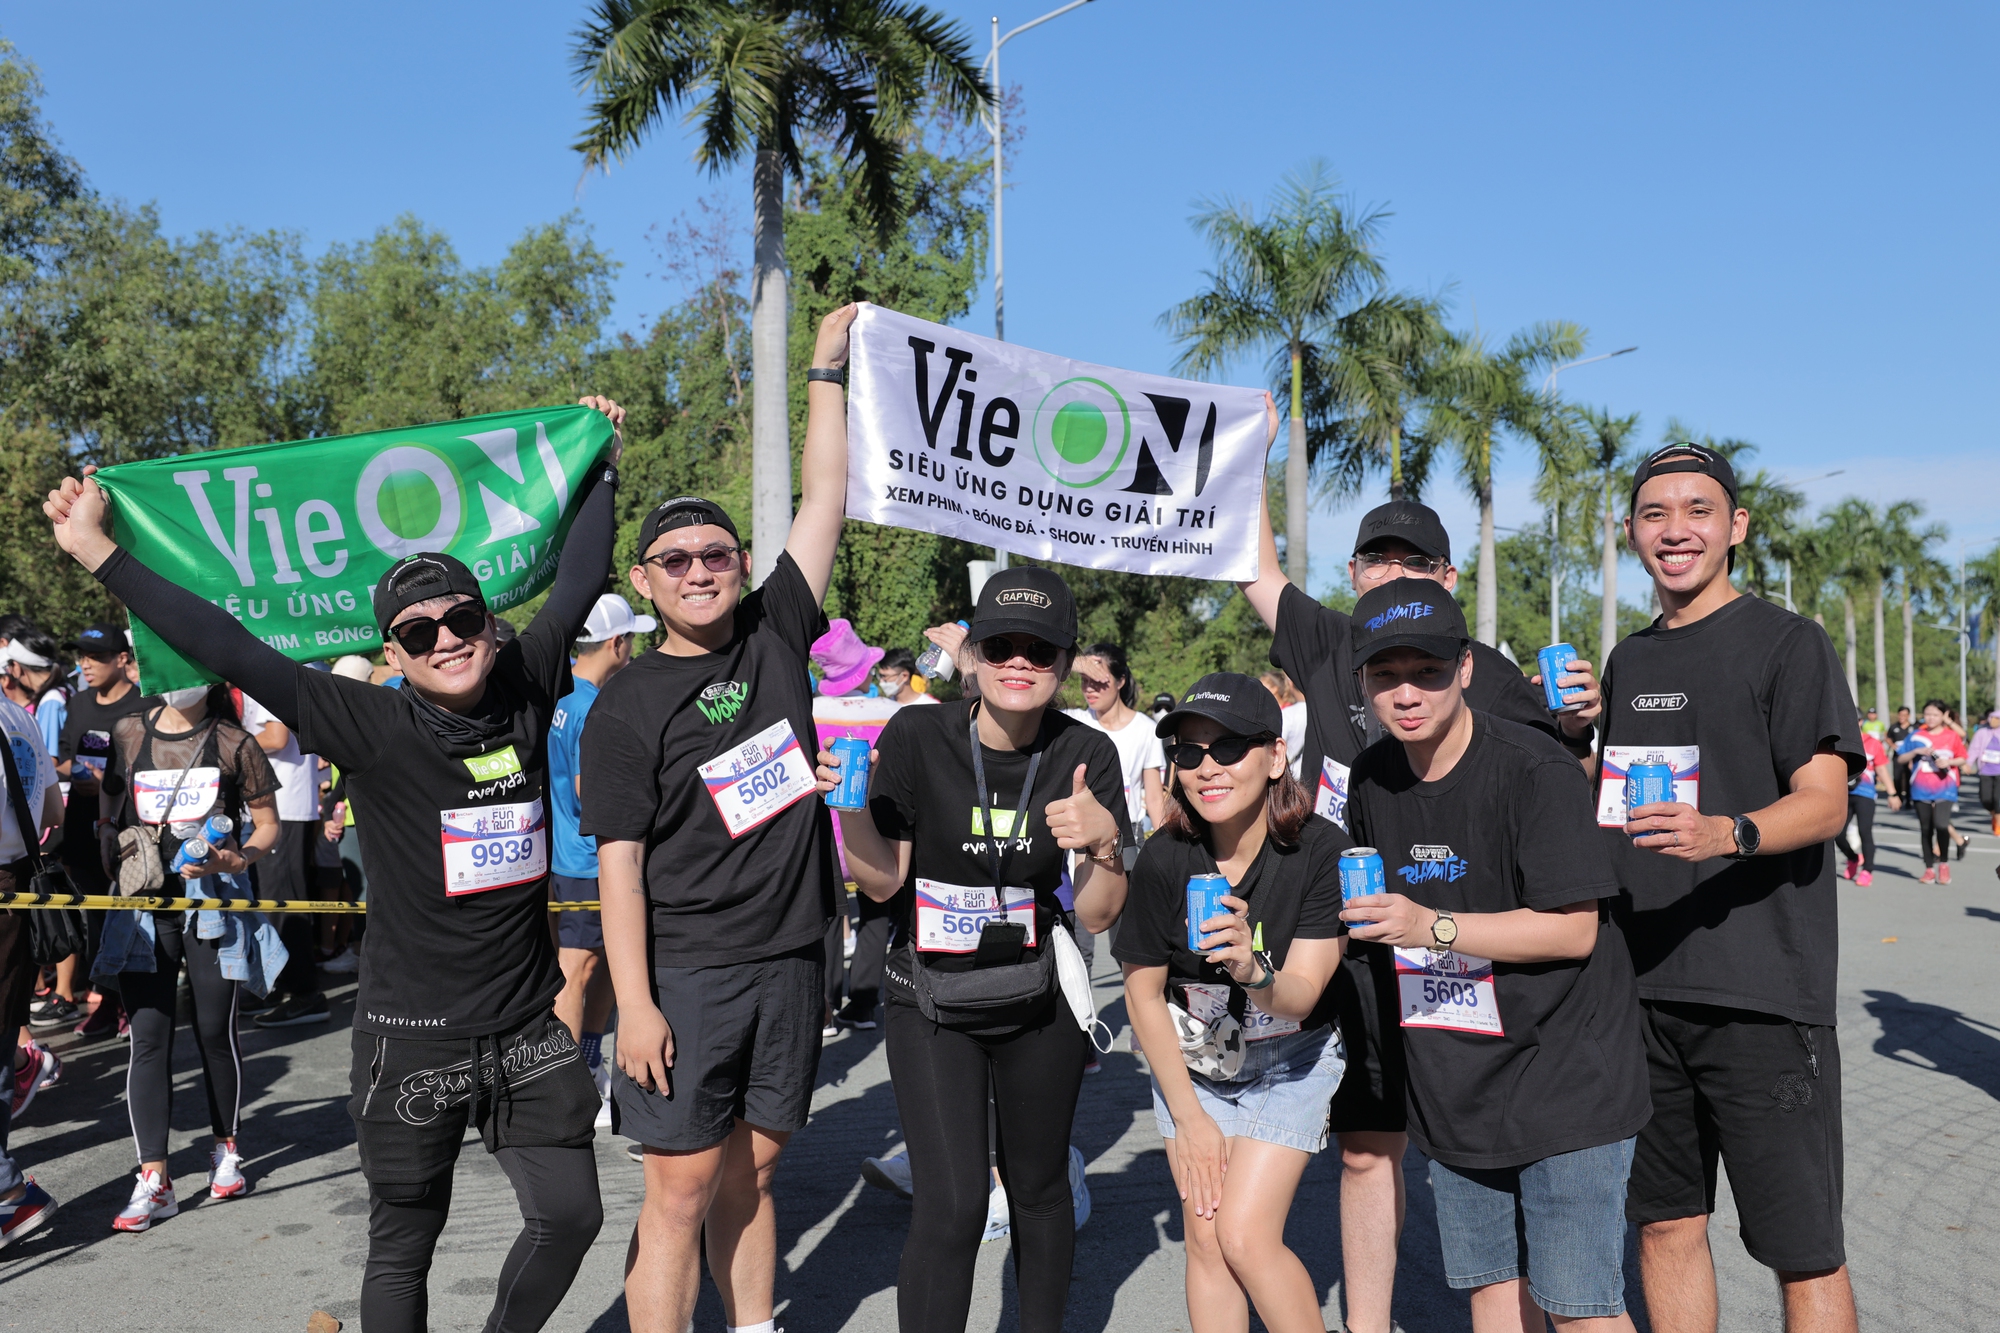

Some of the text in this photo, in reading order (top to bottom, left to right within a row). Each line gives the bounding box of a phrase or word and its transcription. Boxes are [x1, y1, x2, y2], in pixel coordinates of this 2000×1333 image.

[889, 449, 1216, 529] SIÊU ỨNG DỤNG GIẢI TRÍ
[885, 485, 924, 505] XEM
[927, 493, 963, 515] PHIM
[972, 509, 1012, 531] BÓNG
[1015, 519, 1037, 535] ĐÁ
[1049, 527, 1096, 546] SHOW
[1172, 538, 1213, 555] HÌNH
[211, 593, 269, 620] ÊU
[287, 589, 357, 617] ỨNG
[473, 543, 536, 582] GIẢI
[261, 633, 301, 650] HIM
[315, 624, 374, 646] BÓNG
[742, 744, 759, 758] FUN
[746, 752, 763, 767] RUN
[467, 769, 527, 800] everyday
[737, 762, 790, 805] 5602
[492, 810, 514, 820] FUN
[493, 820, 514, 830] RUN
[471, 837, 533, 868] 9939
[964, 892, 985, 900] FUN
[942, 914, 1001, 935] 560
[1438, 960, 1455, 970] RUN
[1423, 979, 1478, 1007] 5603
[367, 1011, 447, 1027] by DatVietVAC
